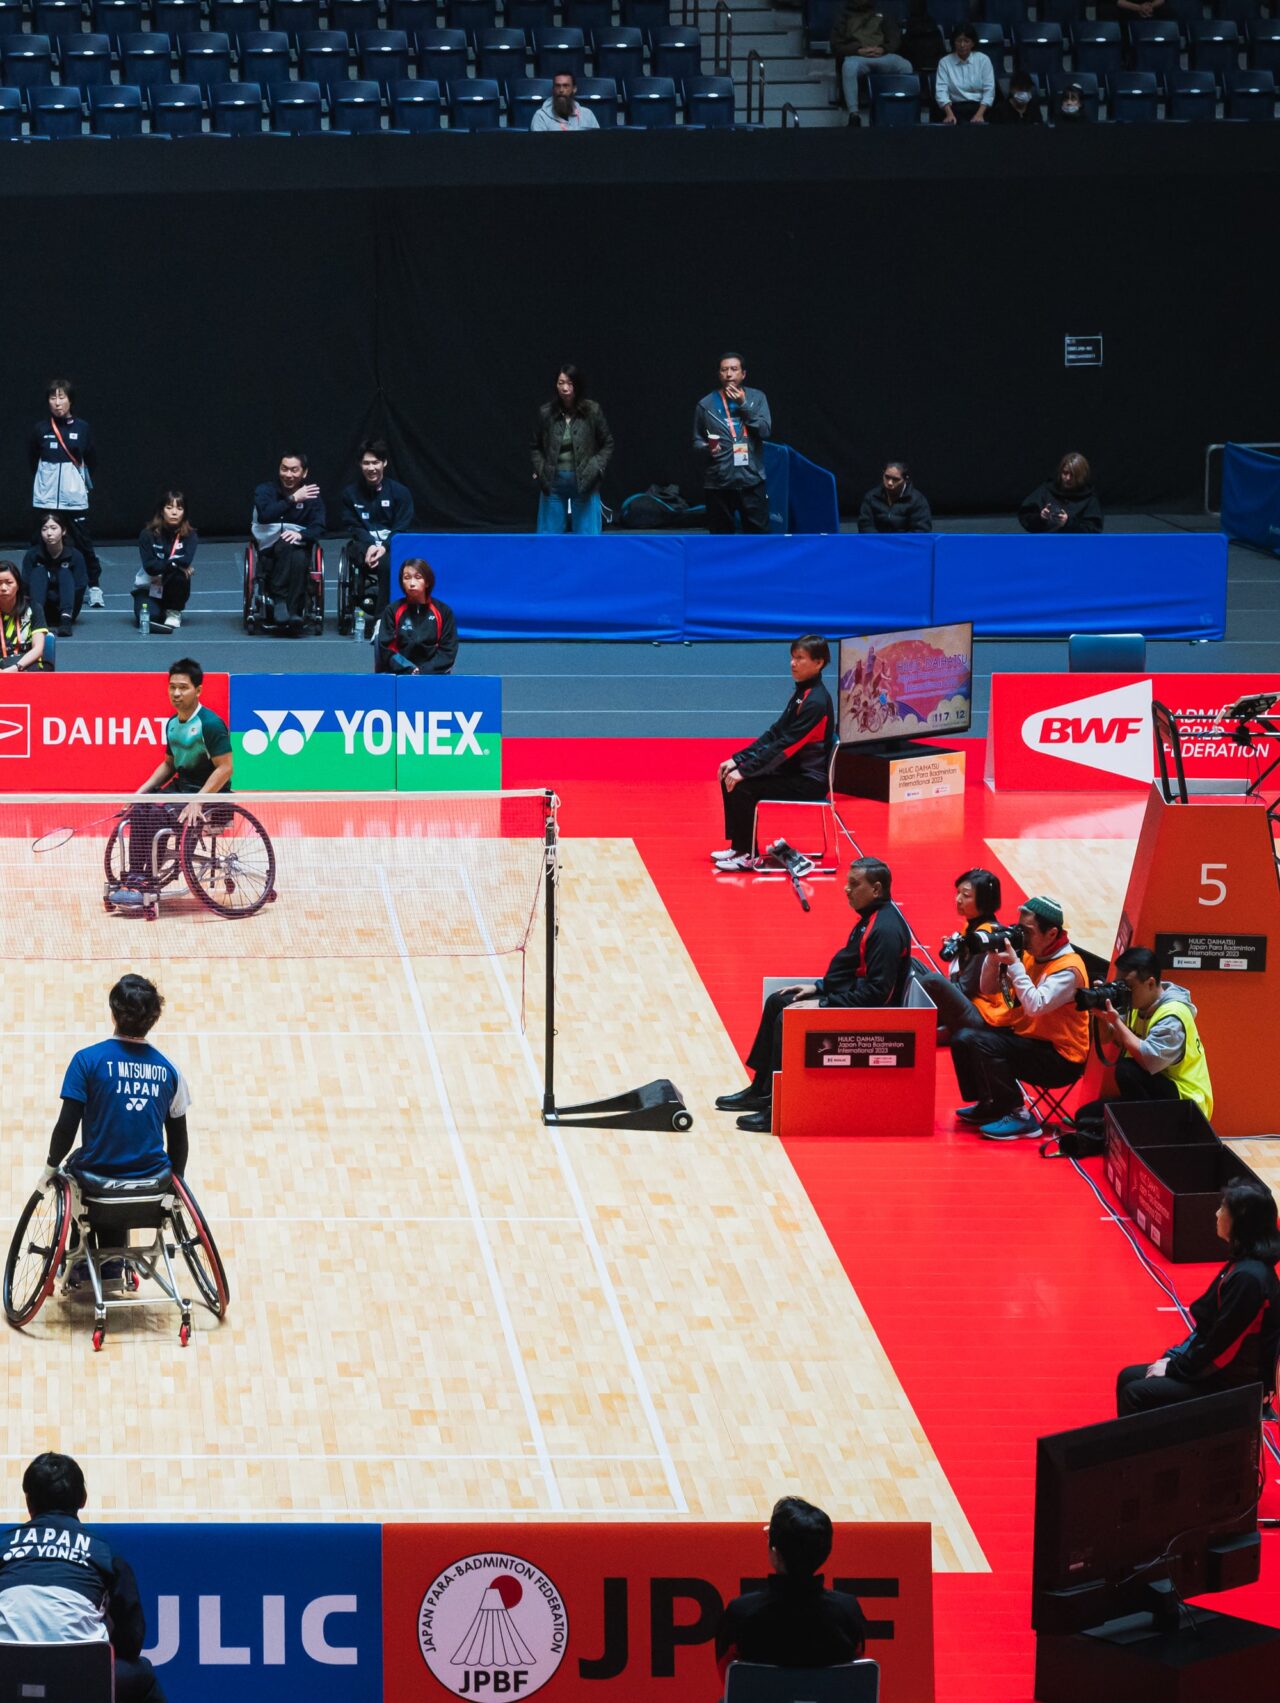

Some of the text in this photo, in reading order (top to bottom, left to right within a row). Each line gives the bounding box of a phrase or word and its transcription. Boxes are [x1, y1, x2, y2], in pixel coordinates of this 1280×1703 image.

[42, 716, 170, 746] DAIHAT
[334, 709, 484, 756] YONEX
[1039, 718, 1143, 744] BWF
[1198, 864, 1228, 906] 5
[106, 1061, 168, 1082] T MATSUMOTO
[116, 1080, 160, 1097] JAPAN
[10, 1528, 90, 1551] JAPAN
[36, 1545, 92, 1567] YONEX
[422, 1556, 565, 1654] JAPAN PARA-BADMINTON FEDERATION
[141, 1594, 358, 1666] ULIC
[458, 1670, 529, 1694] JPBF
